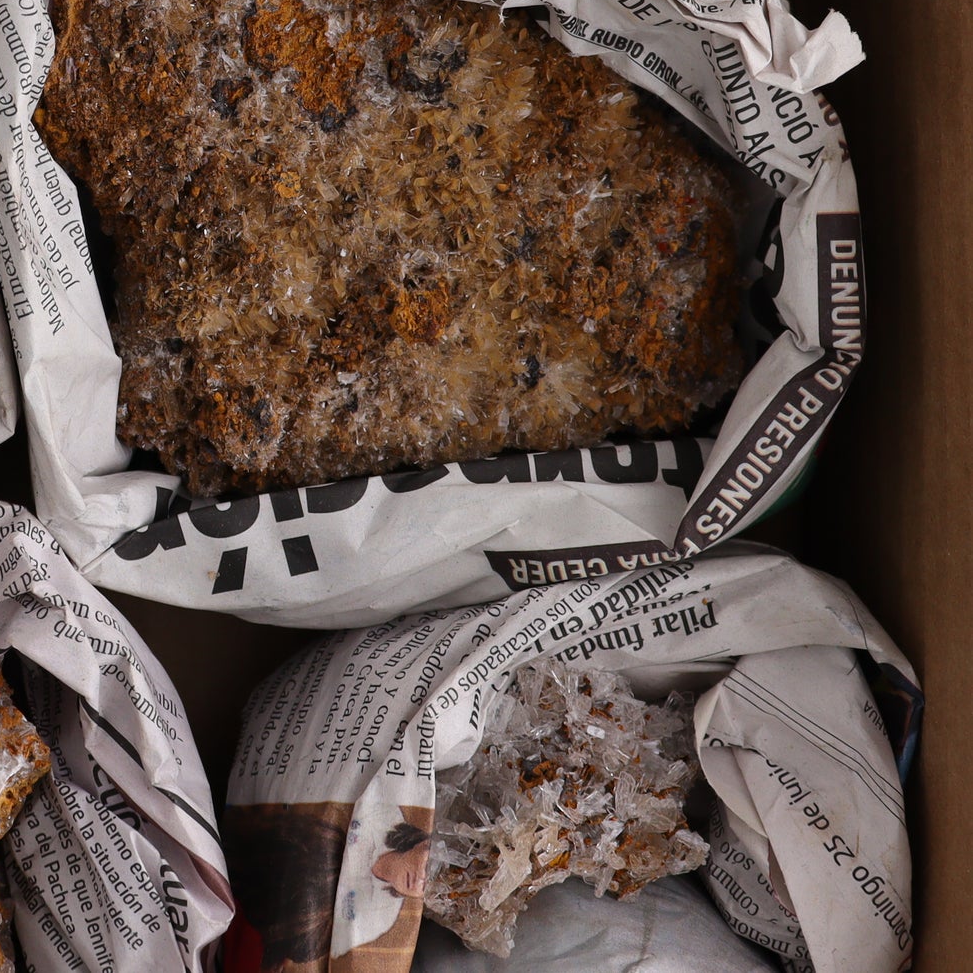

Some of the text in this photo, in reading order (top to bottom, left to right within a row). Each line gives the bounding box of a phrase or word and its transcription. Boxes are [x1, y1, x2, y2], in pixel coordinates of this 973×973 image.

[591, 29, 682, 90] RUBIO GIRON
[704, 37, 760, 125] JUNTO
[0, 94, 17, 116] de
[44, 169, 72, 215] quien
[43, 234, 61, 261] del
[695, 386, 825, 542] PRESIONES
[510, 556, 609, 585] CEDER
[546, 598, 573, 621] los
[651, 601, 719, 637] Pilar
[437, 618, 546, 709] encargados de
[351, 685, 381, 735] hacen
[357, 705, 388, 773] conoci-
[386, 759, 404, 776] el
[803, 803, 829, 830] de
[35, 833, 55, 858] del
[54, 775, 84, 822] sobre
[80, 822, 94, 840] la
[90, 843, 142, 913] situación
[141, 914, 160, 933] de
[720, 842, 755, 870] sólo
[823, 835, 855, 866] 25
[62, 850, 92, 912] de que
[38, 910, 84, 970] femenil
